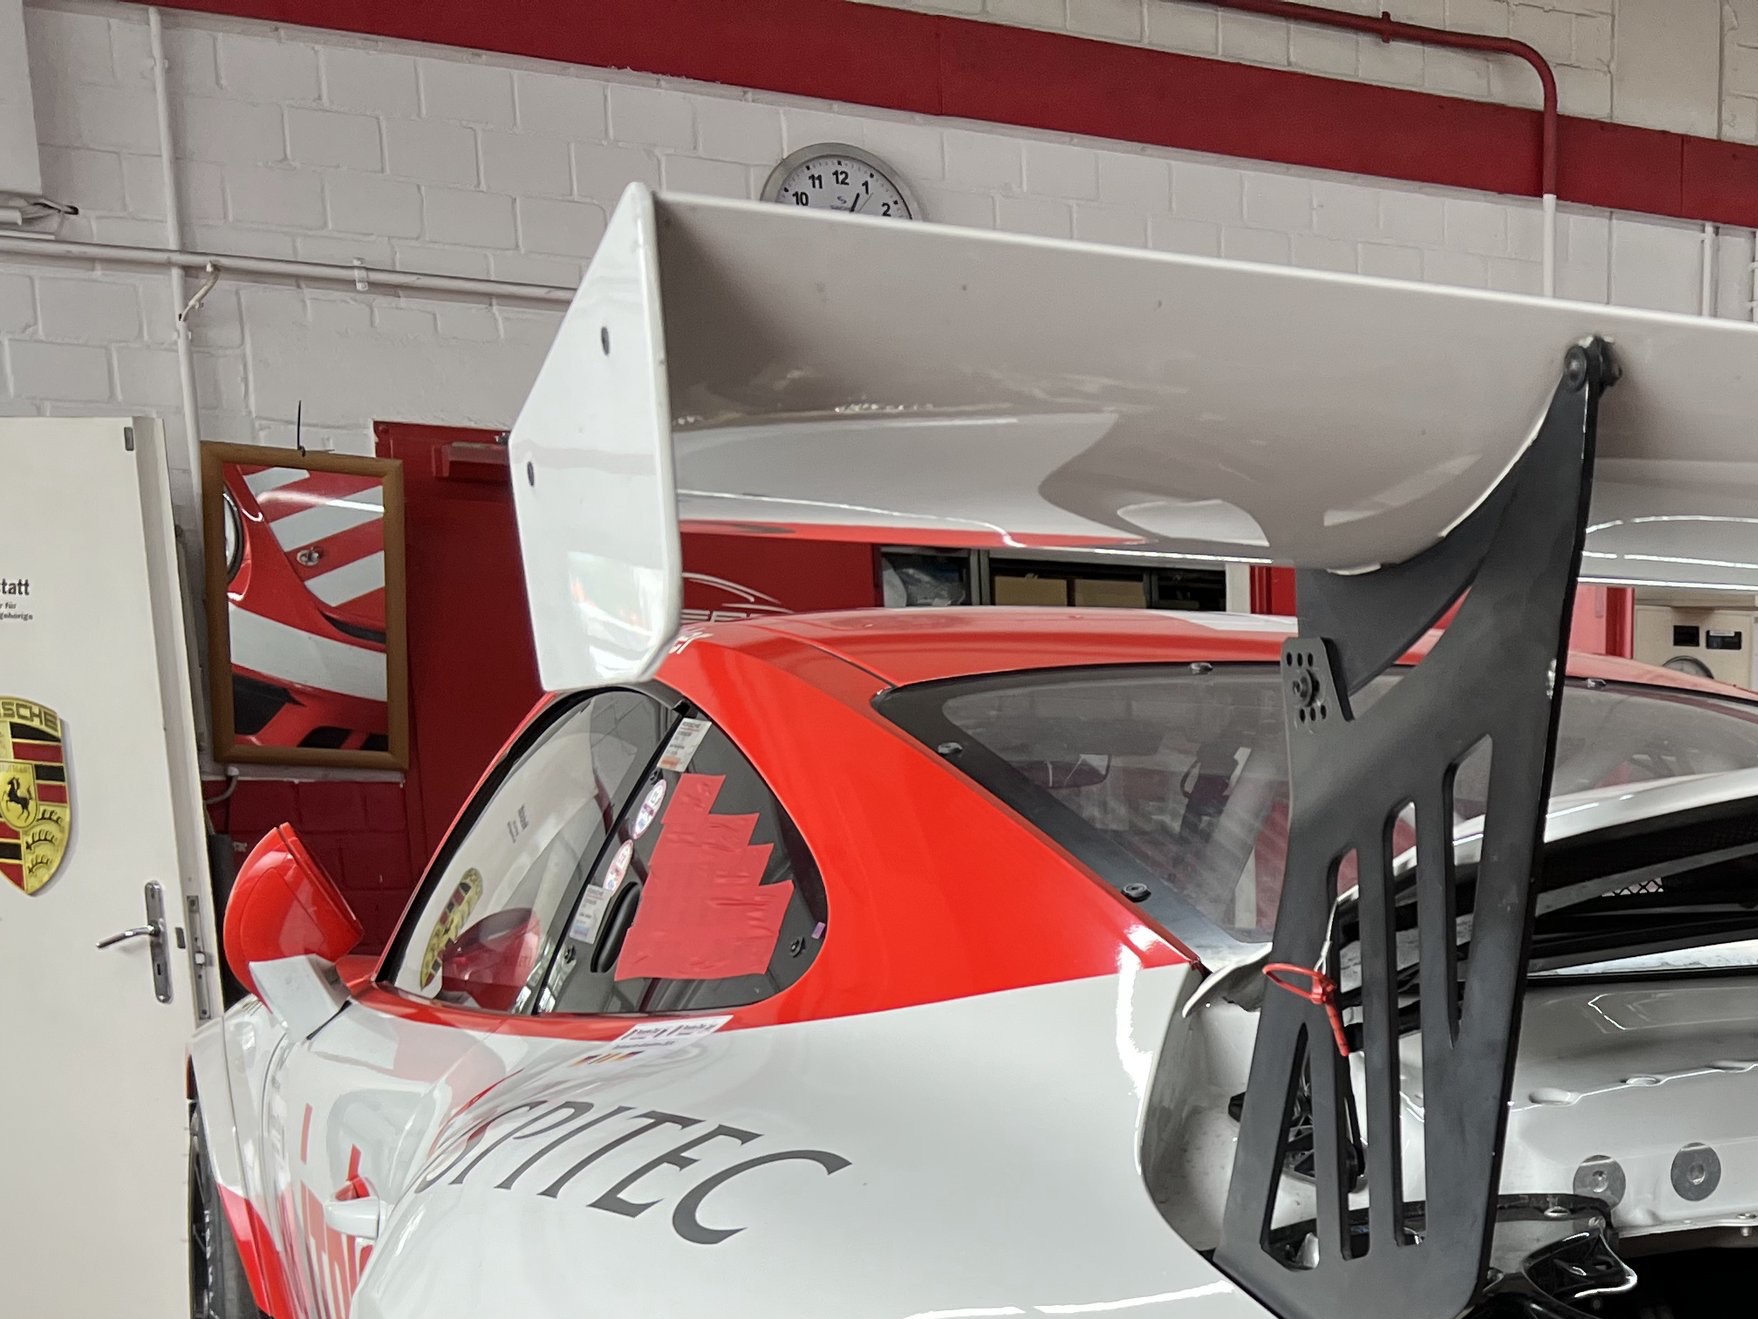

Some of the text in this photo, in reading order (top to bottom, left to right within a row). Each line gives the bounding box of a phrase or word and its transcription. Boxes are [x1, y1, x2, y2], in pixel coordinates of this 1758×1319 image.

[809, 174, 823, 189] 11
[832, 170, 850, 185] 12
[862, 180, 869, 195] 1
[793, 191, 809, 206] 10
[882, 203, 891, 217] 2
[0, 578, 30, 596] tatt
[0, 701, 59, 733] SCHE
